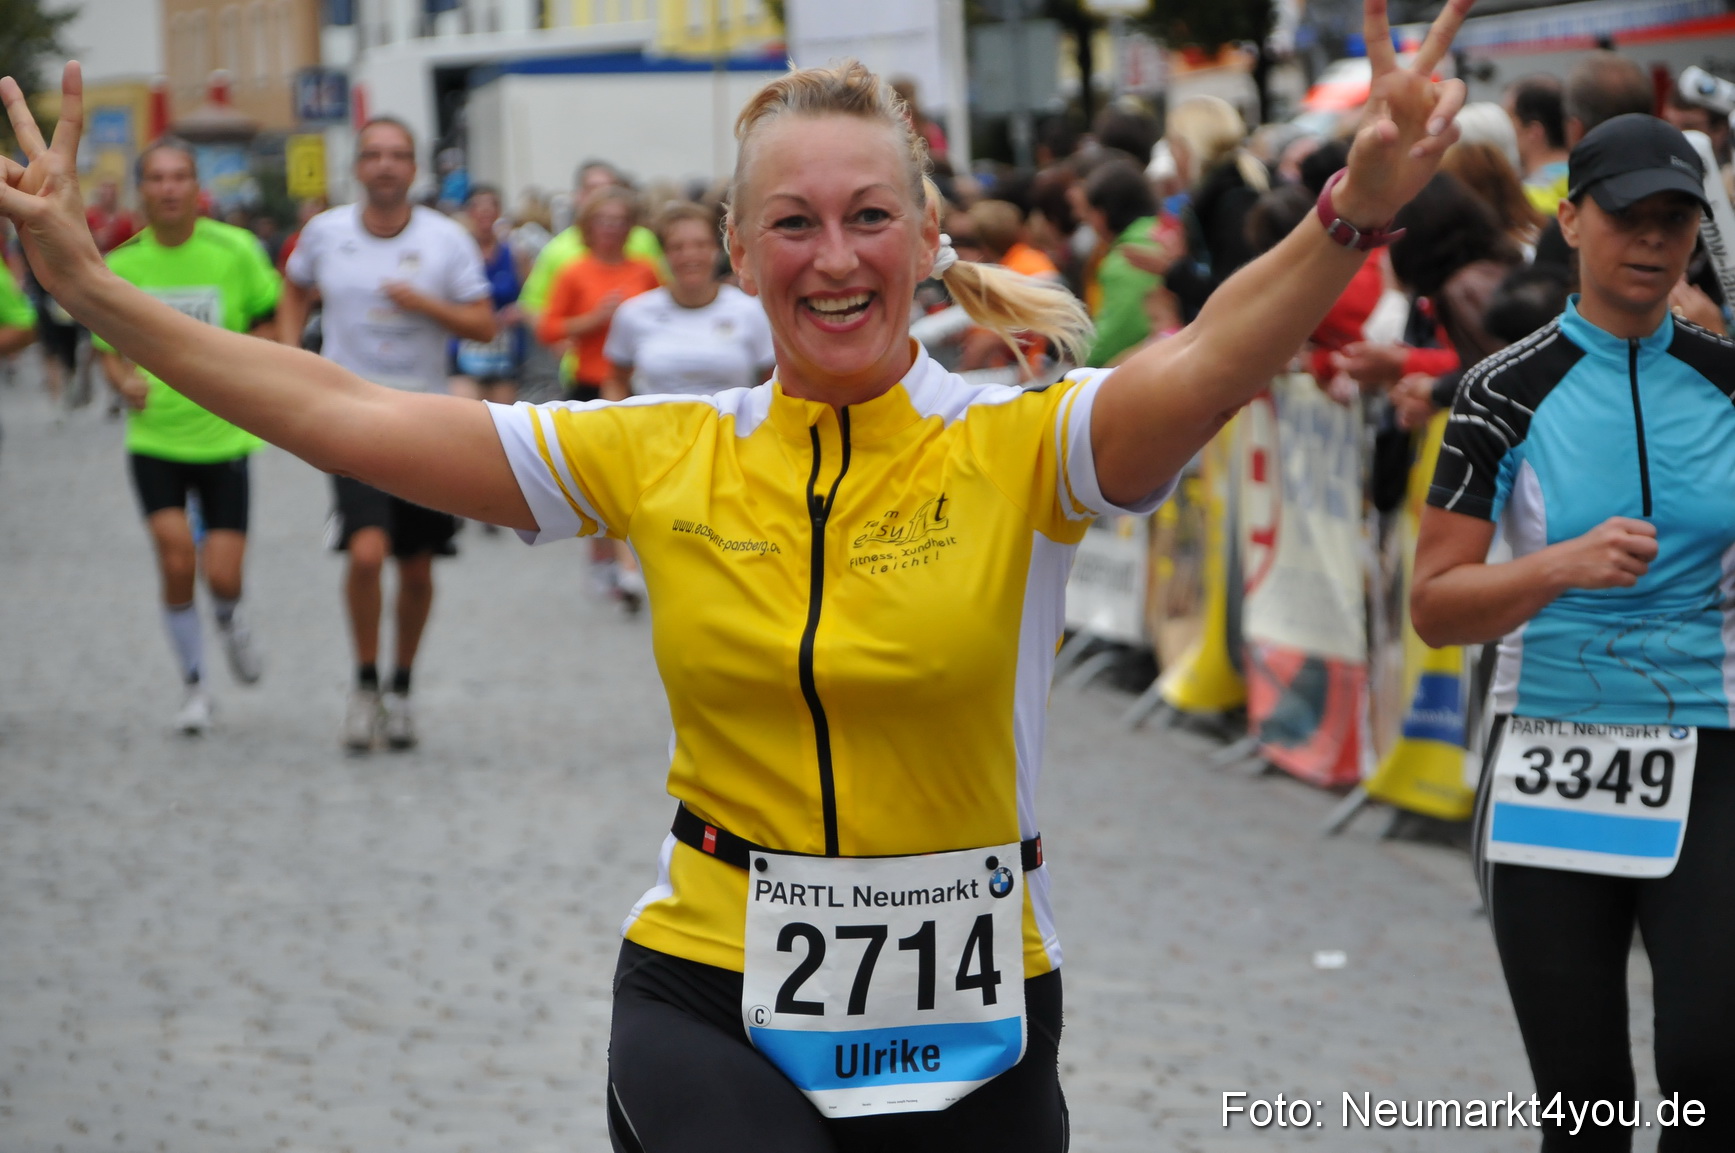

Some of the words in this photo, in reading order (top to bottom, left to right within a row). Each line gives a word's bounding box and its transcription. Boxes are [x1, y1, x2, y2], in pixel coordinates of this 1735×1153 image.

[1510, 719, 1568, 736] PARTL
[1573, 722, 1662, 739] Neumarkt
[1515, 746, 1675, 808] 3349
[755, 879, 845, 908] PARTL
[852, 878, 979, 908] Neumarkt
[774, 913, 1001, 1016] 2714
[834, 1038, 942, 1080] Ulrike
